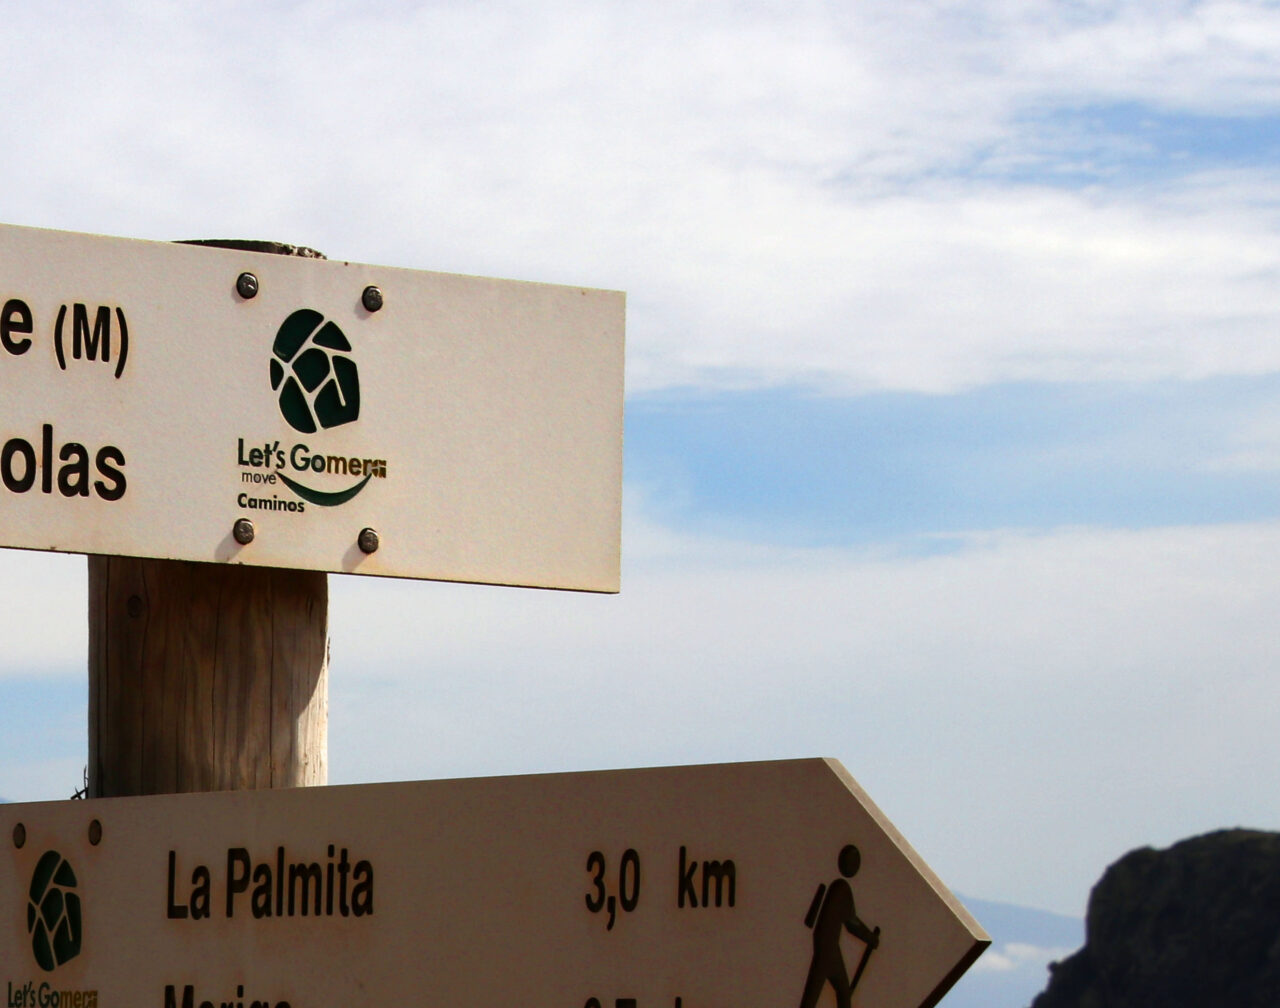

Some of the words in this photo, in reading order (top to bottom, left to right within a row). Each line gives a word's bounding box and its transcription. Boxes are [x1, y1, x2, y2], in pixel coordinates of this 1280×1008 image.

[53, 302, 129, 380] (M)
[238, 438, 285, 469] Let's
[241, 470, 277, 484] move
[237, 492, 305, 513] Caminos
[167, 850, 211, 921] La
[225, 844, 374, 920] Palmita
[585, 848, 641, 932] 3,0
[677, 845, 736, 909] km
[8, 981, 35, 1008] Let's
